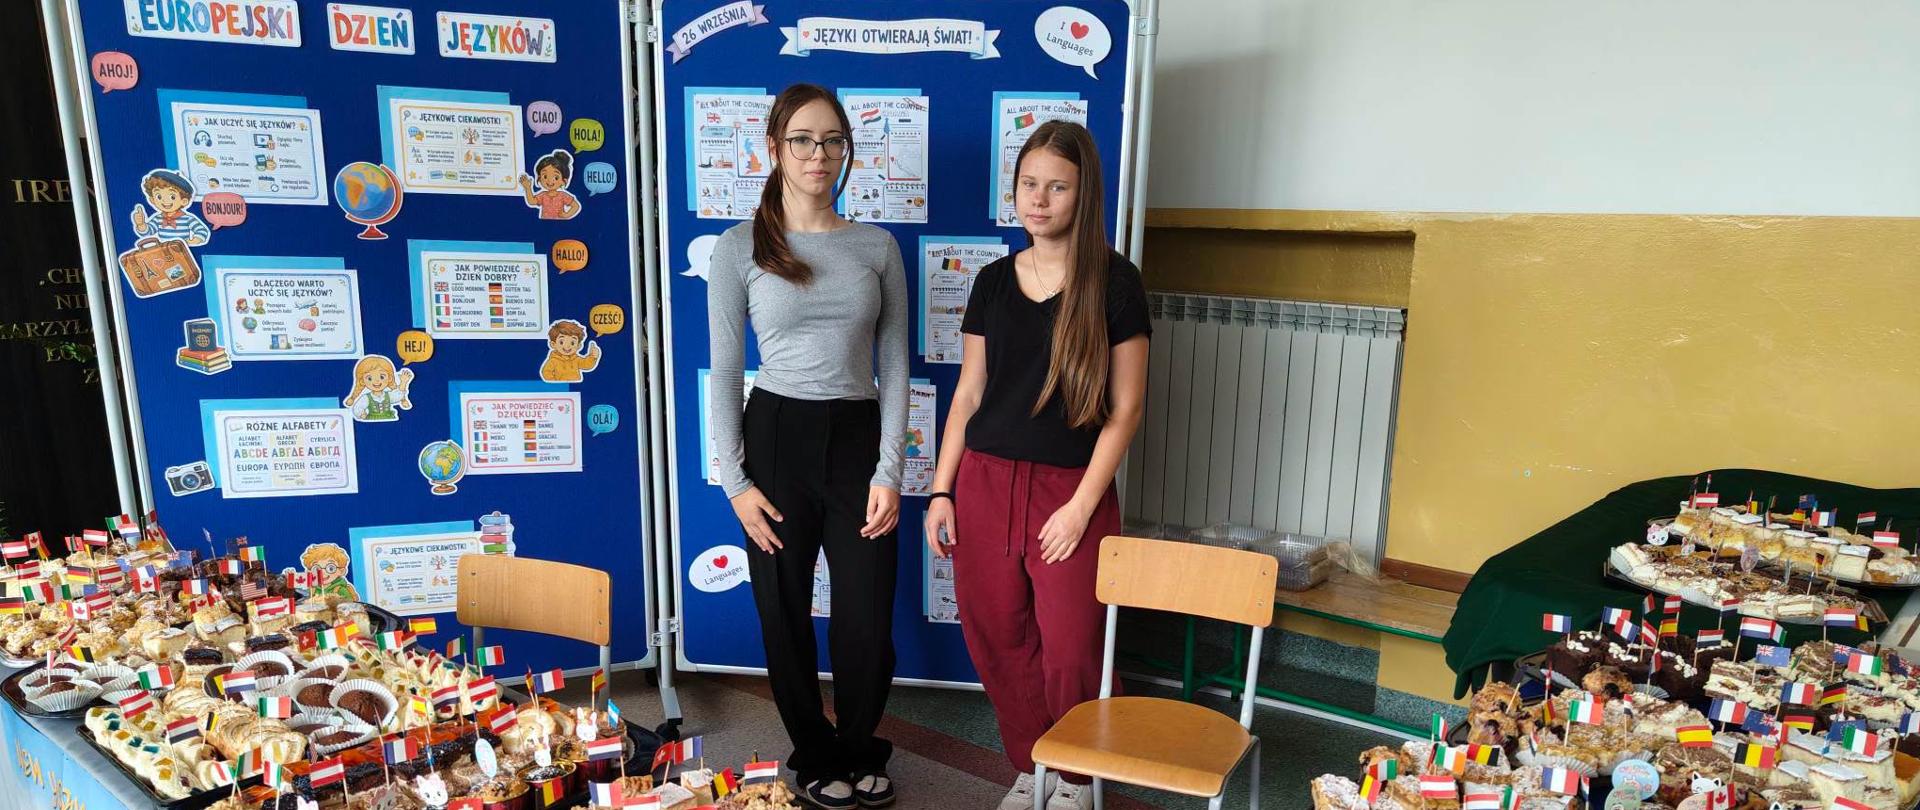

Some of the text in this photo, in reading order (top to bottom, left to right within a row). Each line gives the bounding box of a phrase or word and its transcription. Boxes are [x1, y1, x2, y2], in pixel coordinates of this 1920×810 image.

[140, 0, 543, 56] EUROPEJSKI DZIEŃ JĘZYKÓW
[681, 6, 748, 46] 26 WRZEŚNIA
[1060, 22, 1066, 31] I
[813, 25, 973, 47] JĘZYKI OTWIERAJĄ ŚWIAT!
[1046, 31, 1095, 57] Languages
[99, 62, 133, 79] AHOJ!
[204, 117, 296, 130] JAK UCZYĆ SIĘ JĘZYKÓW?
[419, 113, 501, 125] JĘZYKOWE CIEKAWOSTKI
[532, 111, 557, 124] CIAO!
[573, 128, 600, 142] HOLA!
[587, 171, 614, 184] HELLO!
[205, 202, 243, 216] BONJOUR!
[555, 249, 584, 261] HALLO!
[454, 264, 521, 273] JAK POWIEDZIEĆ
[253, 279, 325, 288] DLACZEGO WARTO
[484, 273, 517, 281] DOBRY?
[248, 288, 333, 299] UCZYĆ SIĘ JĘZYKÓW?
[593, 312, 621, 325] CZEŚĆ!
[404, 341, 426, 354] HEJ!
[592, 411, 613, 425] OLÁ!
[281, 421, 327, 430] ALFABETY
[234, 448, 269, 459] ABCDE
[236, 463, 269, 472] EUROPA
[389, 542, 467, 555] JĘZYKOWE CIEKAWOSTKI
[706, 564, 711, 572] I
[704, 565, 744, 586] Languages
